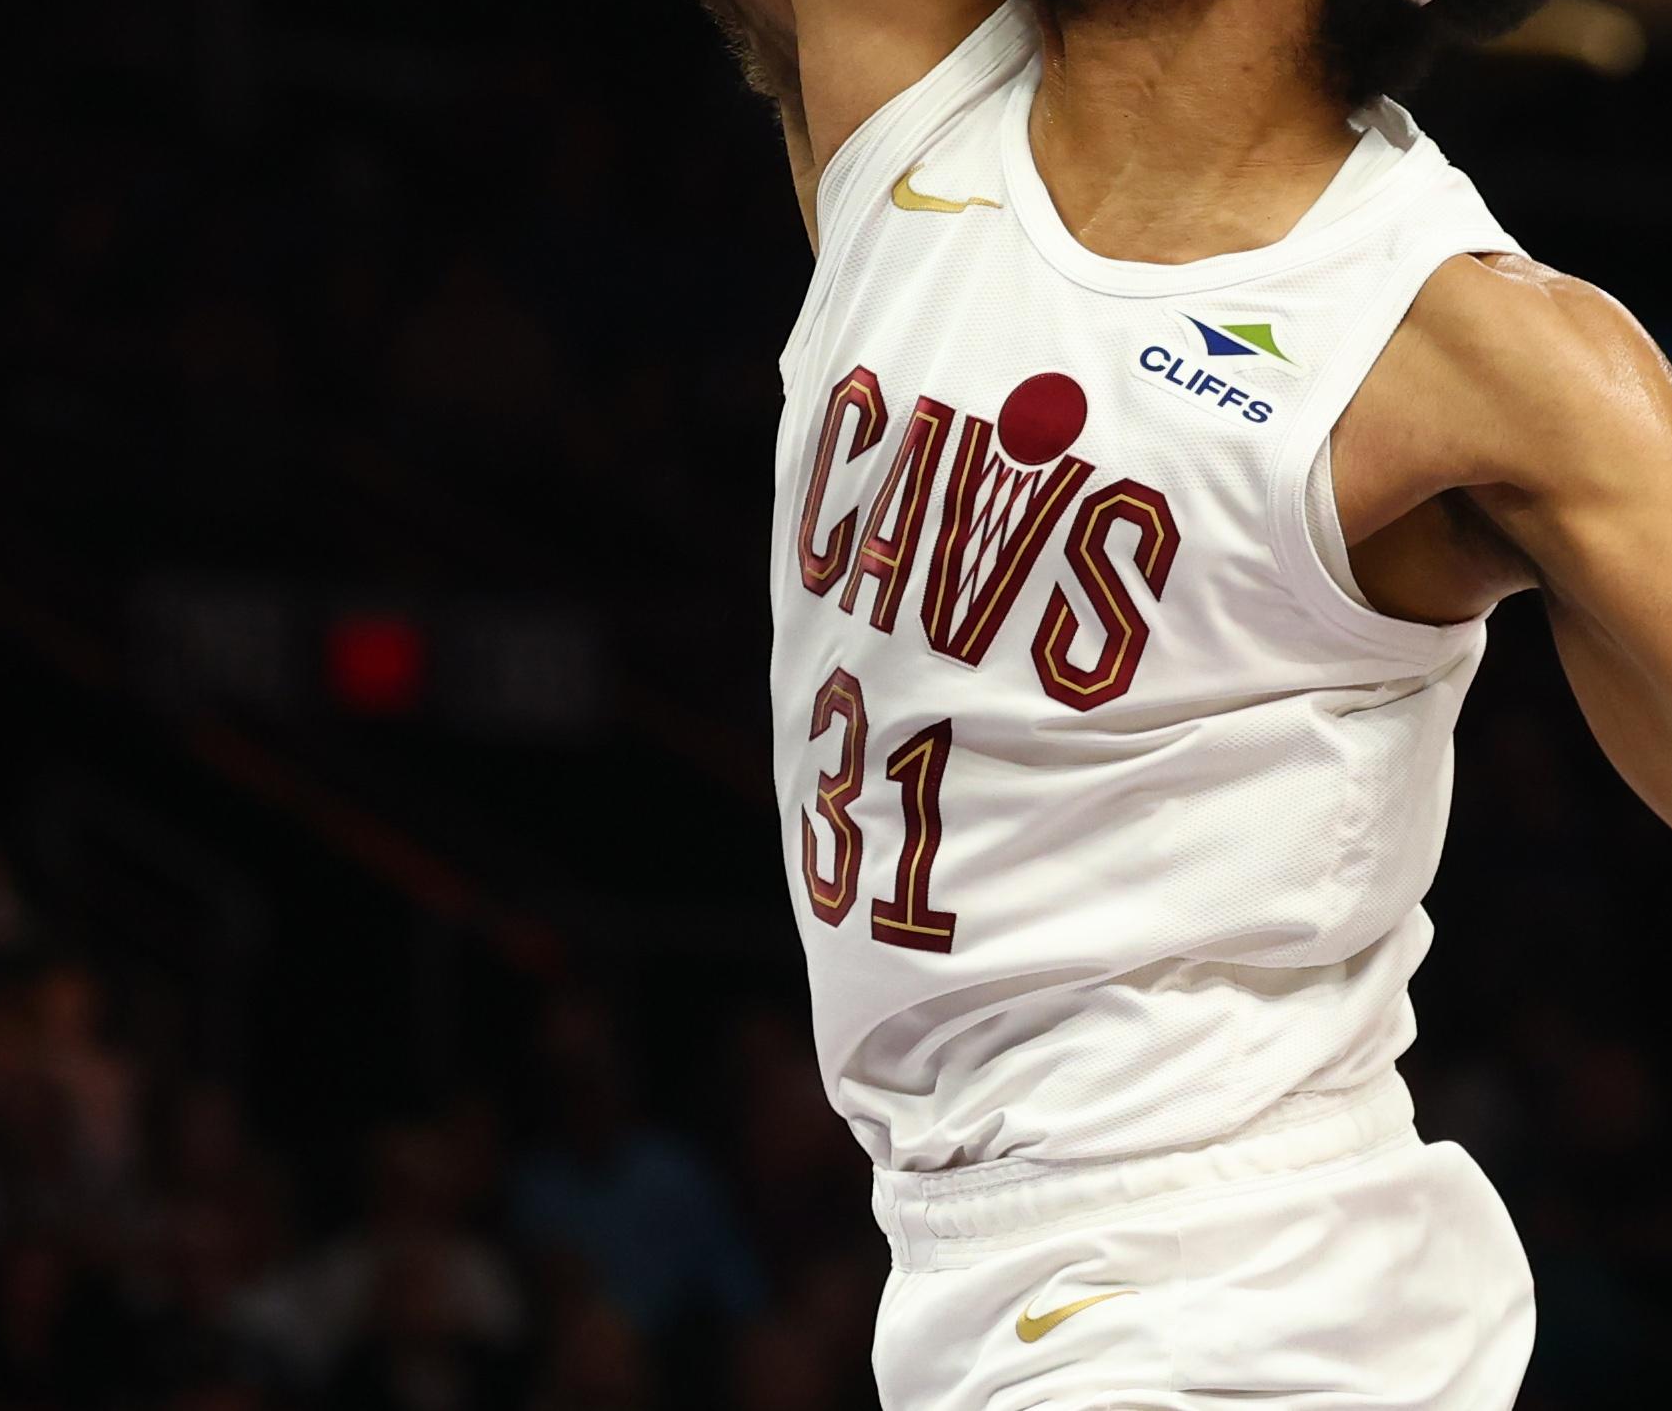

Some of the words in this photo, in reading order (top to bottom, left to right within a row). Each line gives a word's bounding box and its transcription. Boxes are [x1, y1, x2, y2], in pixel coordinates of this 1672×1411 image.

[1138, 344, 1273, 425] CLIFFS
[797, 364, 1182, 711] CAVS
[801, 666, 957, 954] 31
